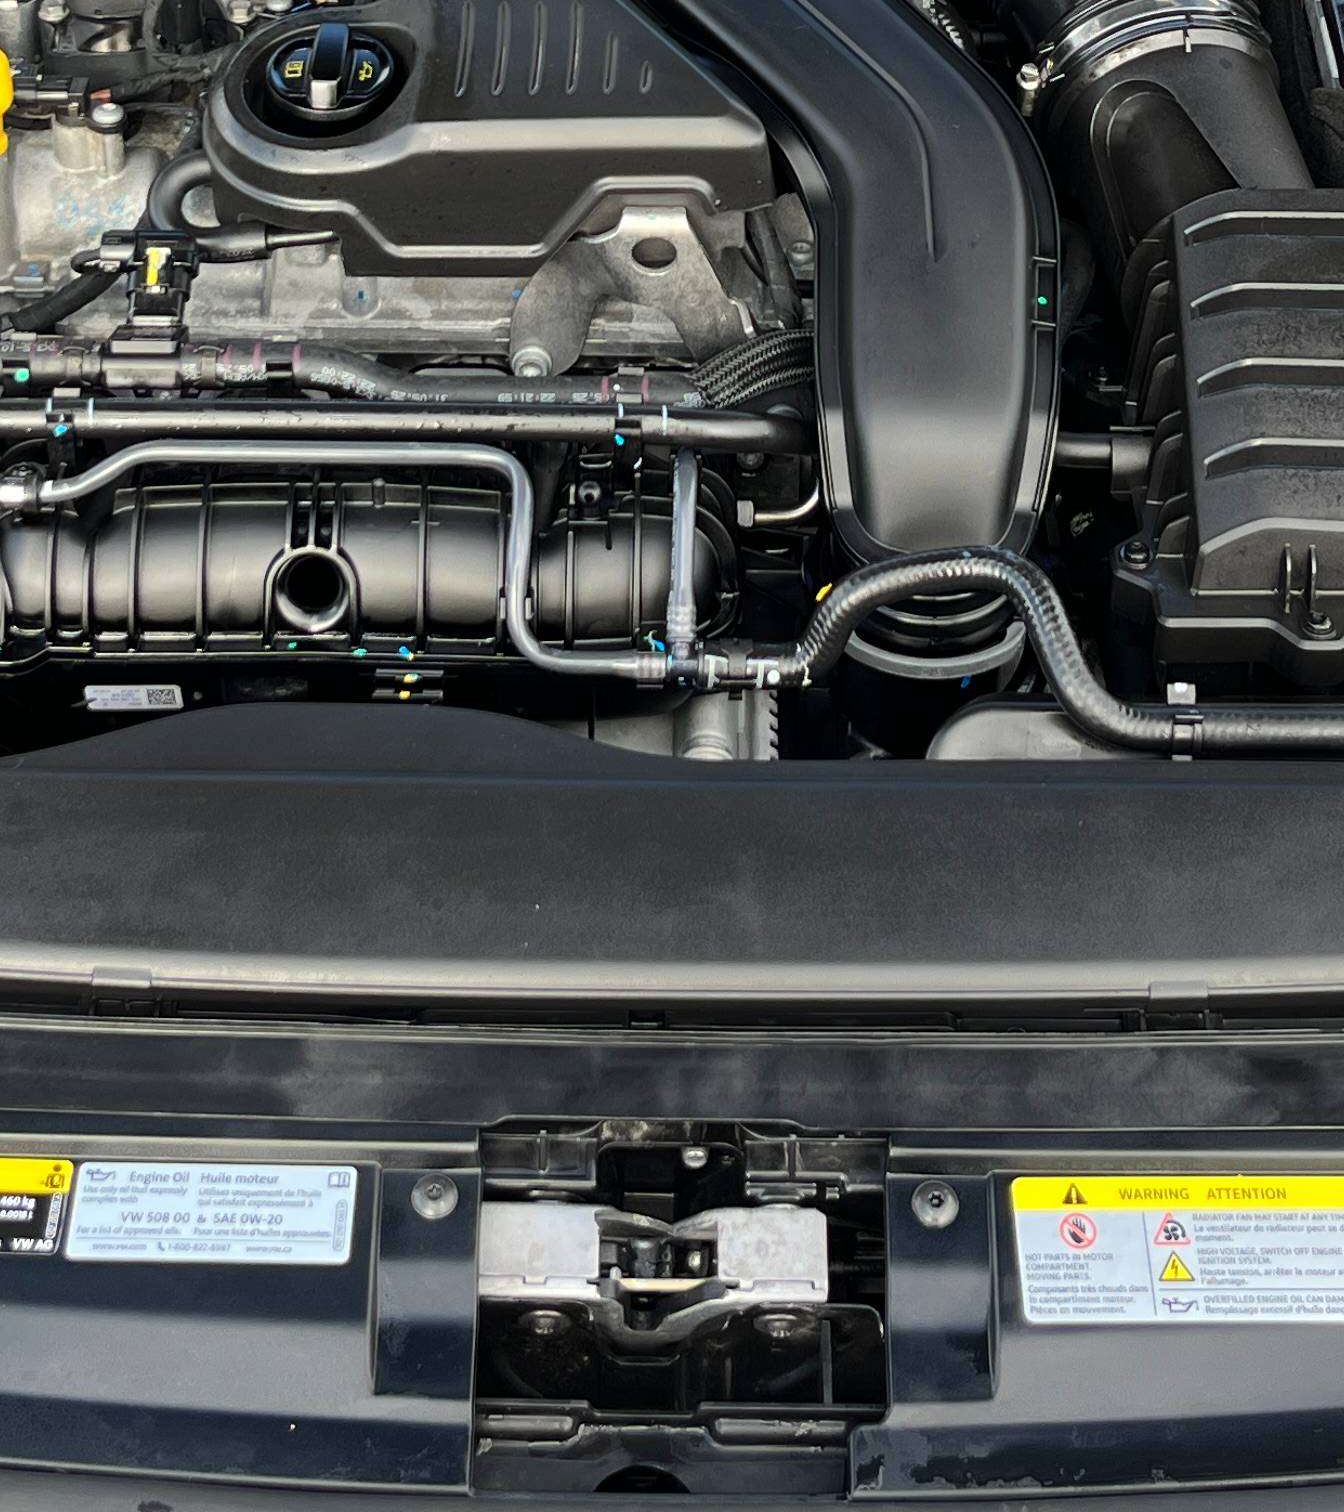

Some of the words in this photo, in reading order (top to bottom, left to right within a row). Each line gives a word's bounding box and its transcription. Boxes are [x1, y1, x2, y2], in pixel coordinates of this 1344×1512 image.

[129, 1171, 170, 1185] Engine
[172, 1171, 191, 1183] Oil
[200, 1172, 232, 1184] Huile
[234, 1173, 280, 1185] moteur
[1118, 1187, 1190, 1201] WARNING
[1206, 1187, 1288, 1201] ATTENTION
[120, 1211, 144, 1223] VW
[146, 1211, 170, 1223] 508
[173, 1212, 191, 1224] 00
[196, 1214, 207, 1224] &
[213, 1212, 237, 1224] SAE
[240, 1213, 284, 1225] 0W-20
[11, 1238, 34, 1250] VW
[35, 1238, 54, 1250] AG
